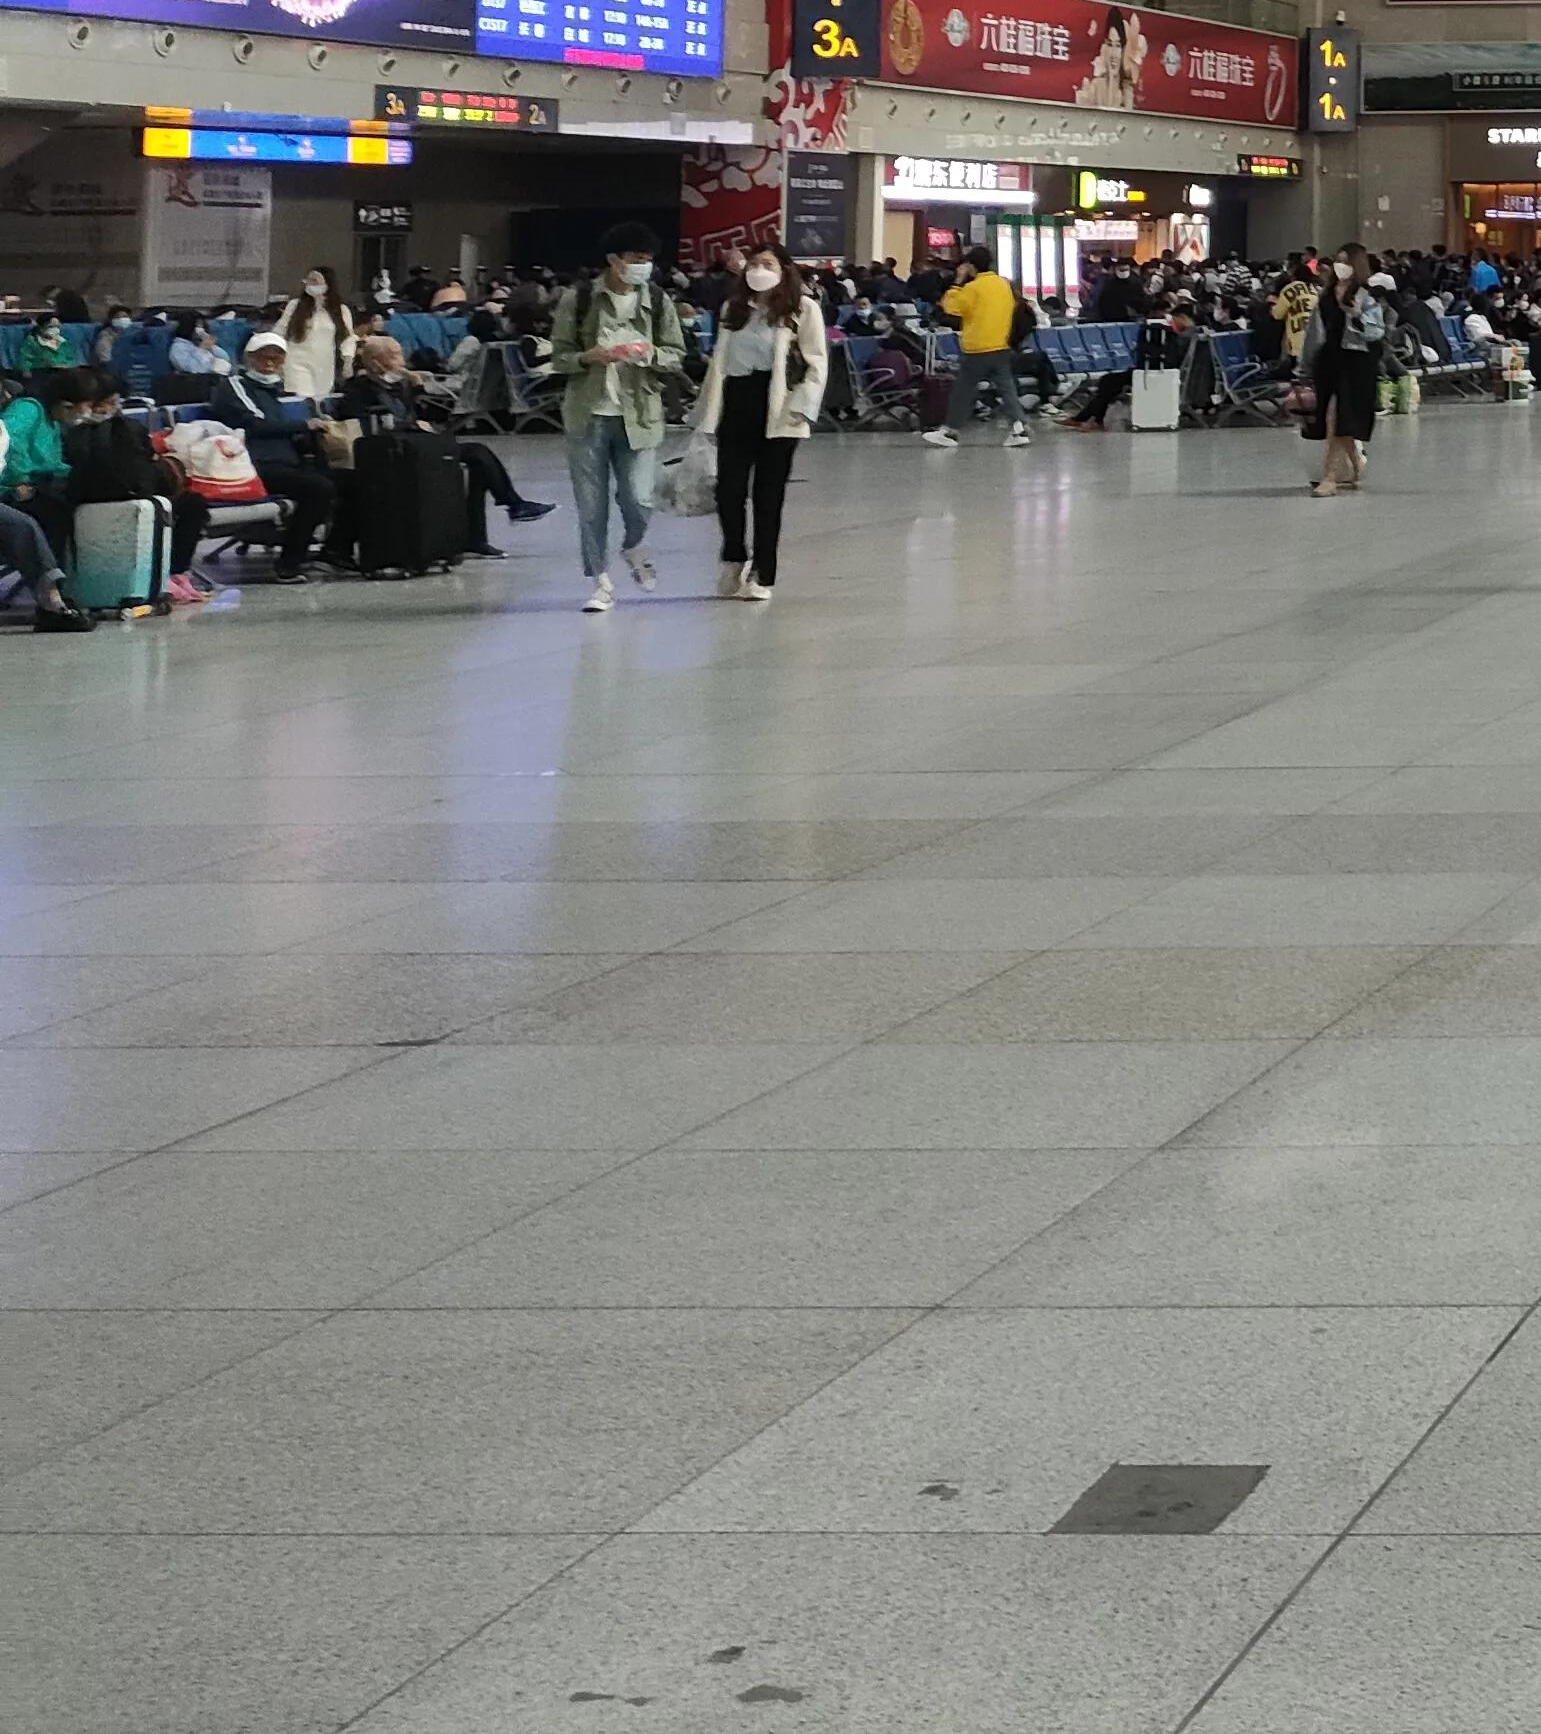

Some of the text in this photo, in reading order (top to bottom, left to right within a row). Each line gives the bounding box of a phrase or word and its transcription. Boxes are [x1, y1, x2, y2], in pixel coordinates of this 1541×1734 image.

[811, 18, 859, 59] 3A
[979, 12, 1071, 62] 六桂福珠宝
[1319, 39, 1346, 68] 1A
[1187, 46, 1256, 88] 六桂福珠宝
[1319, 91, 1346, 120] 1A
